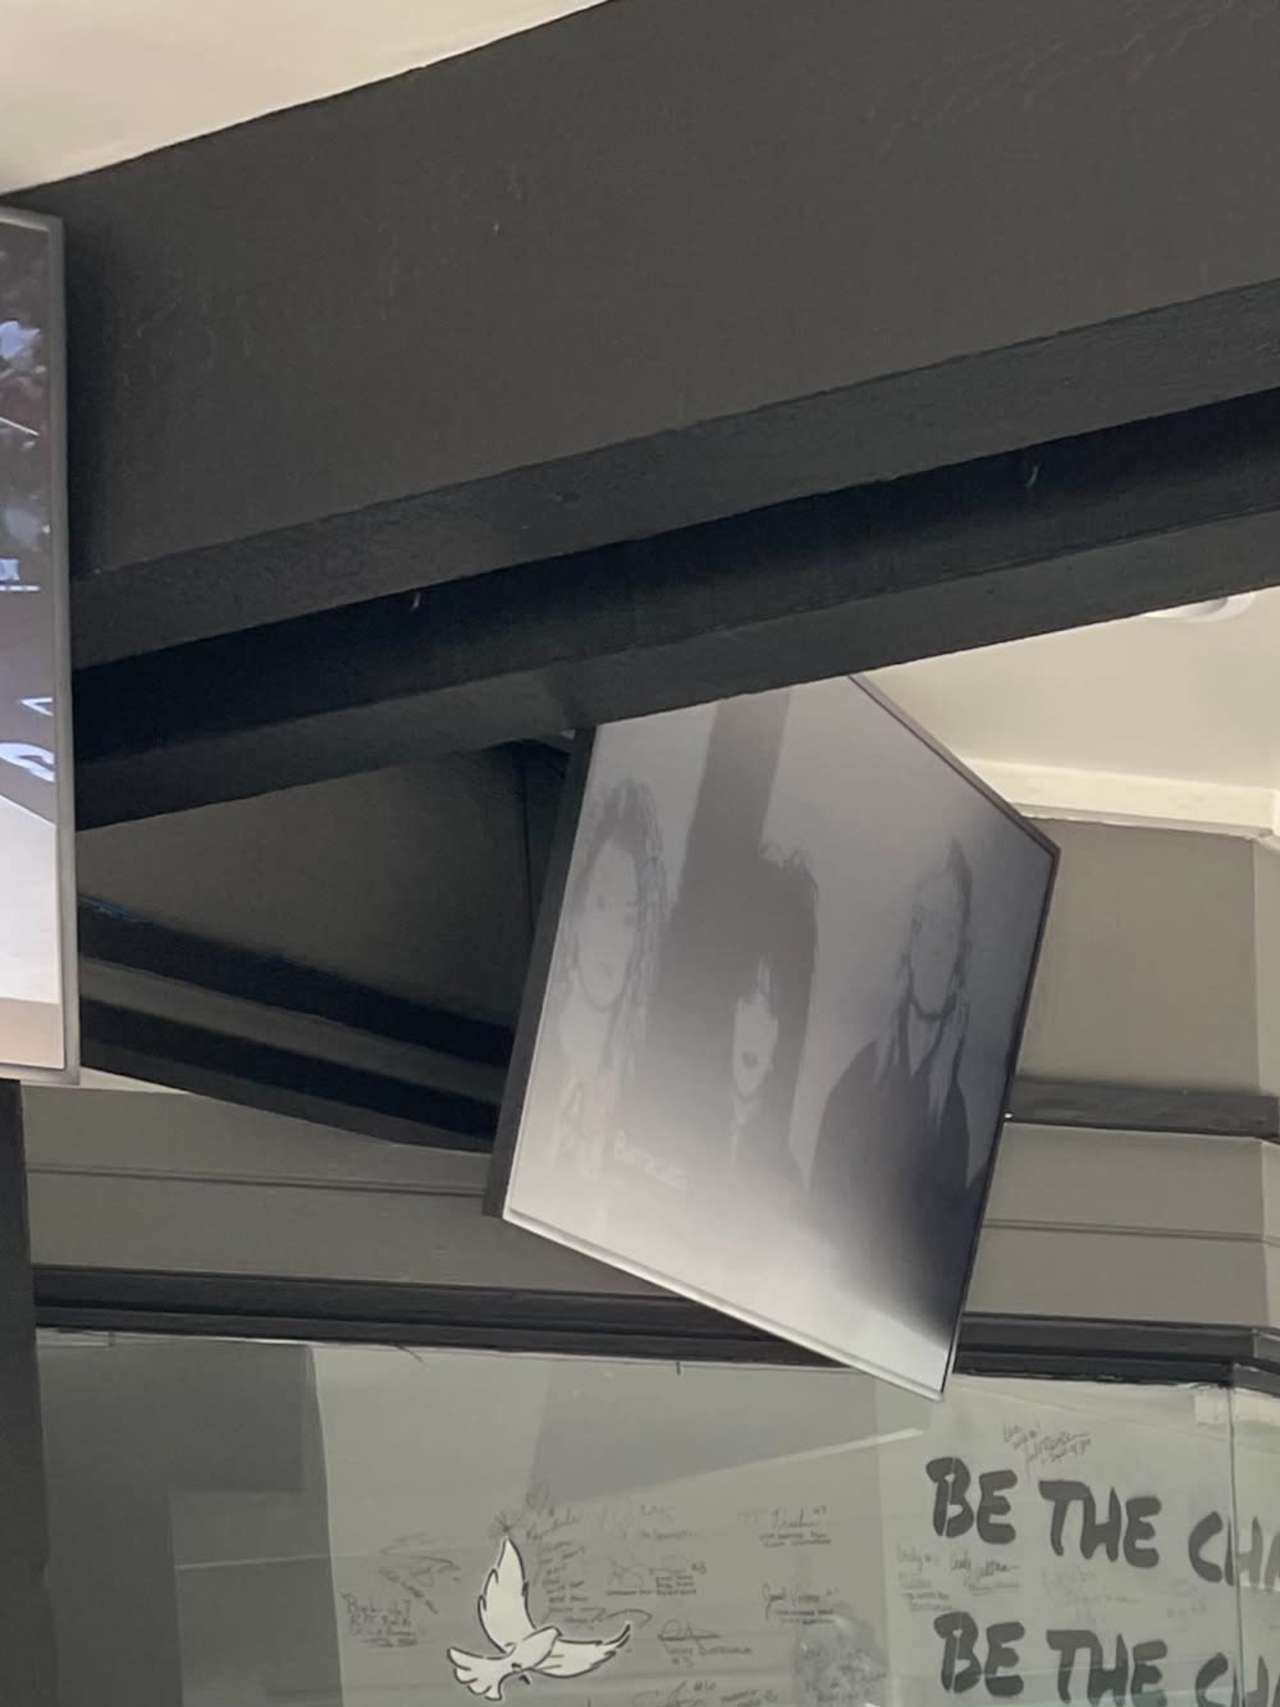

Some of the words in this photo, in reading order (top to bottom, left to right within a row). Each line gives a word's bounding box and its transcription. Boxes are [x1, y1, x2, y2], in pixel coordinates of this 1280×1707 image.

[926, 1457, 1017, 1544] BE
[1039, 1480, 1162, 1568] THE
[934, 1611, 1025, 1697] BE
